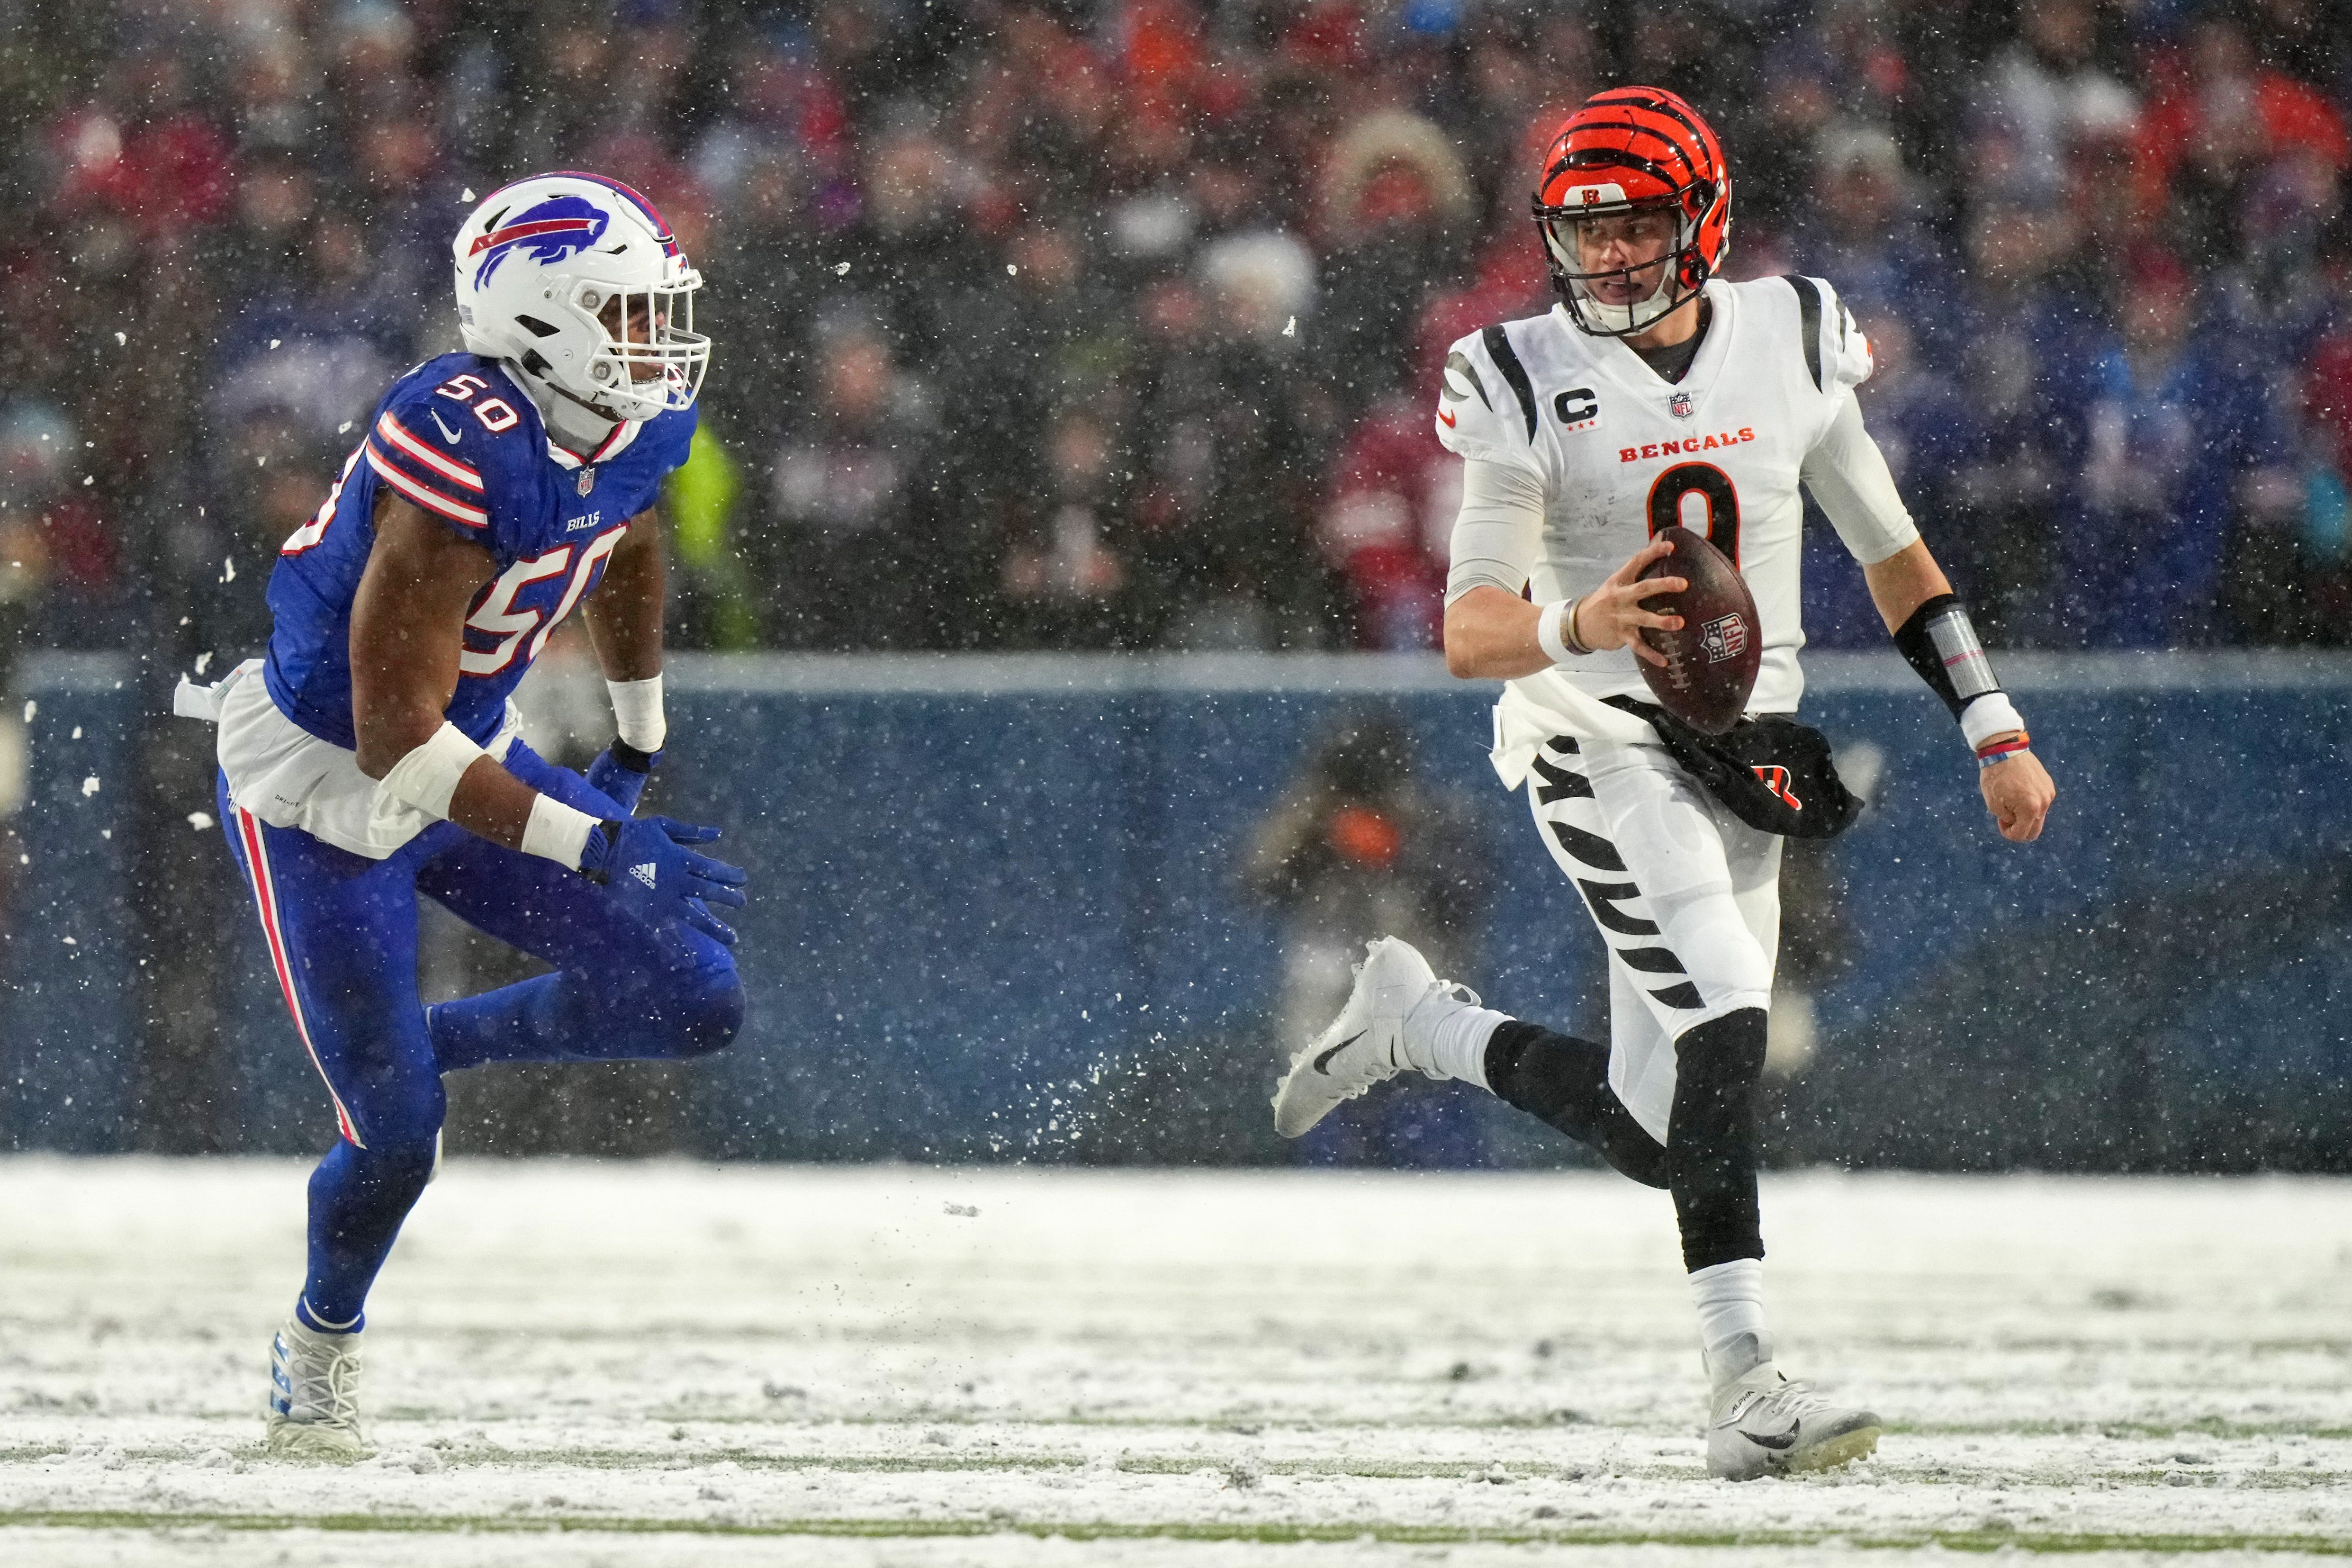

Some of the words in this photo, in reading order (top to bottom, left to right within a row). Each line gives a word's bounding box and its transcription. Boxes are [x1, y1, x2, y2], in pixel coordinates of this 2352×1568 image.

[434, 373, 519, 433] 50
[1554, 387, 1598, 424] C
[1674, 402, 1691, 415] NFL
[1619, 427, 1756, 463] BENGALS
[566, 510, 600, 532] BILLS
[1721, 617, 1743, 653] NFL
[629, 867, 656, 889] adidas
[1731, 1391, 1755, 1415] ALPHA
